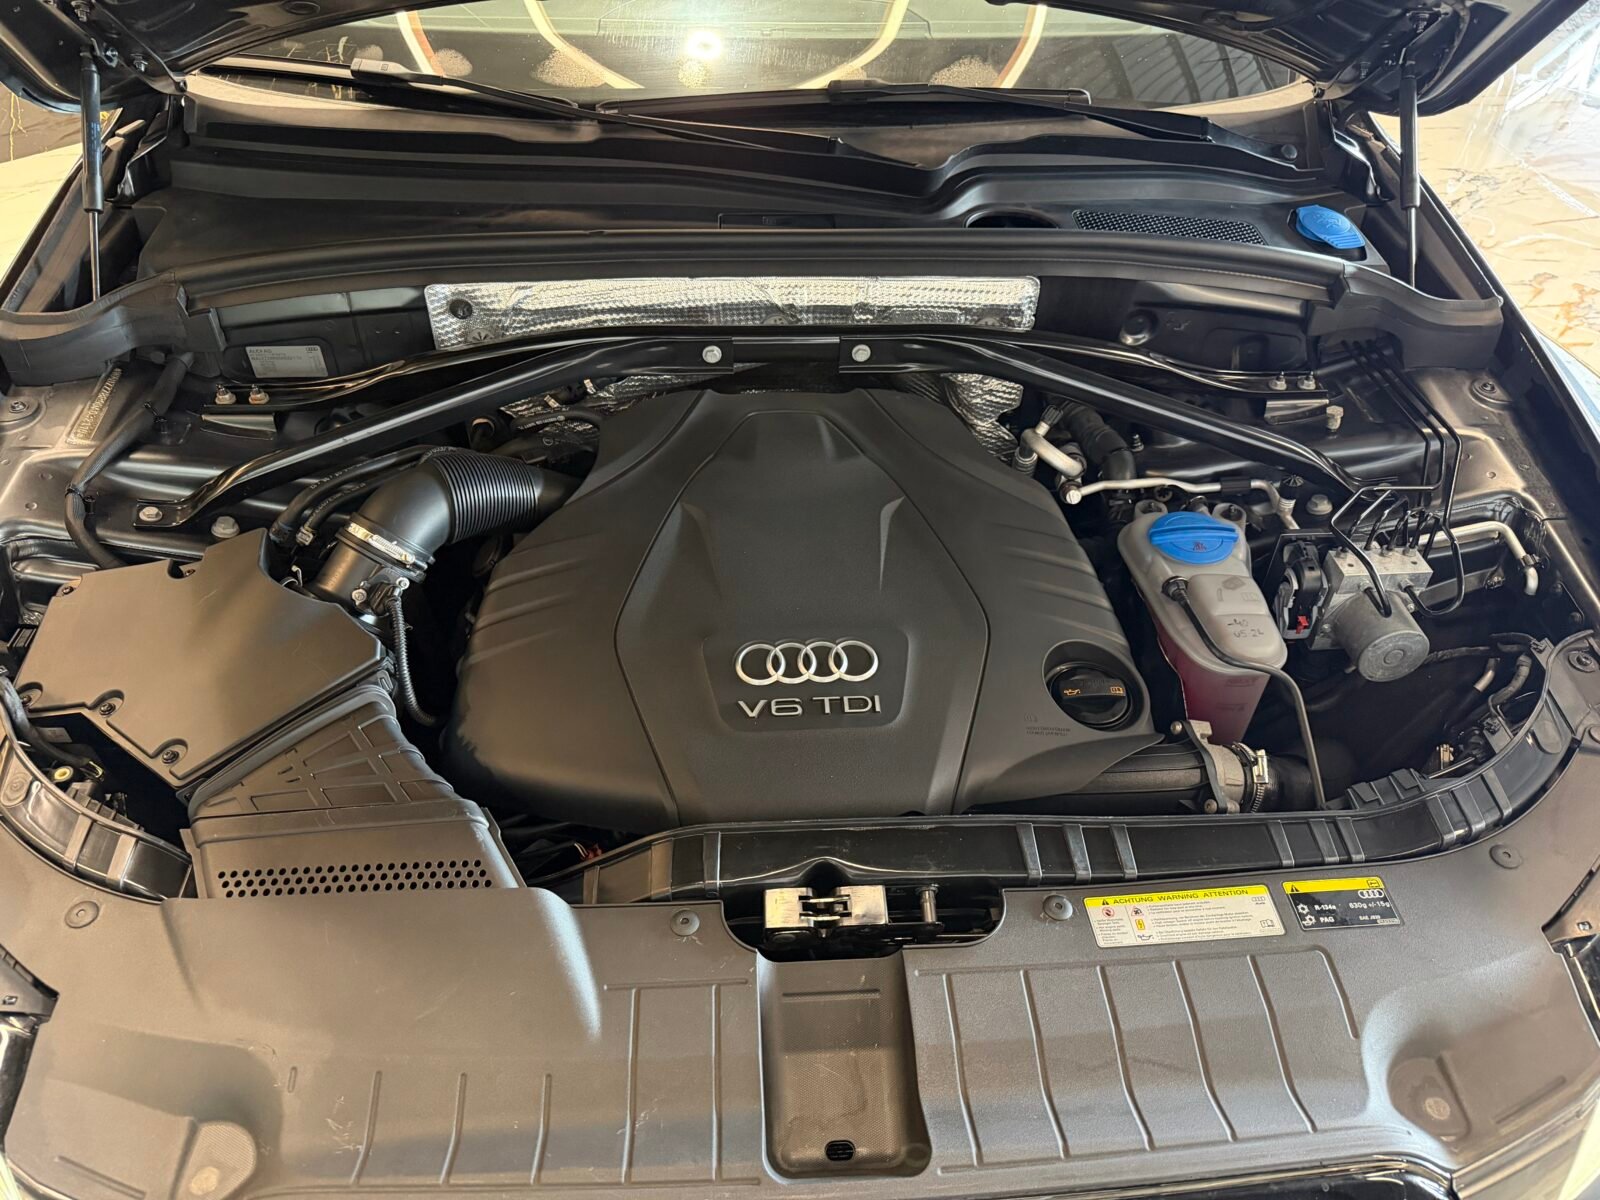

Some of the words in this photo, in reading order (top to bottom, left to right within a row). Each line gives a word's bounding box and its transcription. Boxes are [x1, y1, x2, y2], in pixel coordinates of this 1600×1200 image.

[738, 697, 803, 718] V6
[812, 694, 881, 714] TDI
[1113, 896, 1154, 905] ACHTUNG
[1157, 893, 1199, 902] WARNING
[1203, 889, 1249, 898] ATTENTION
